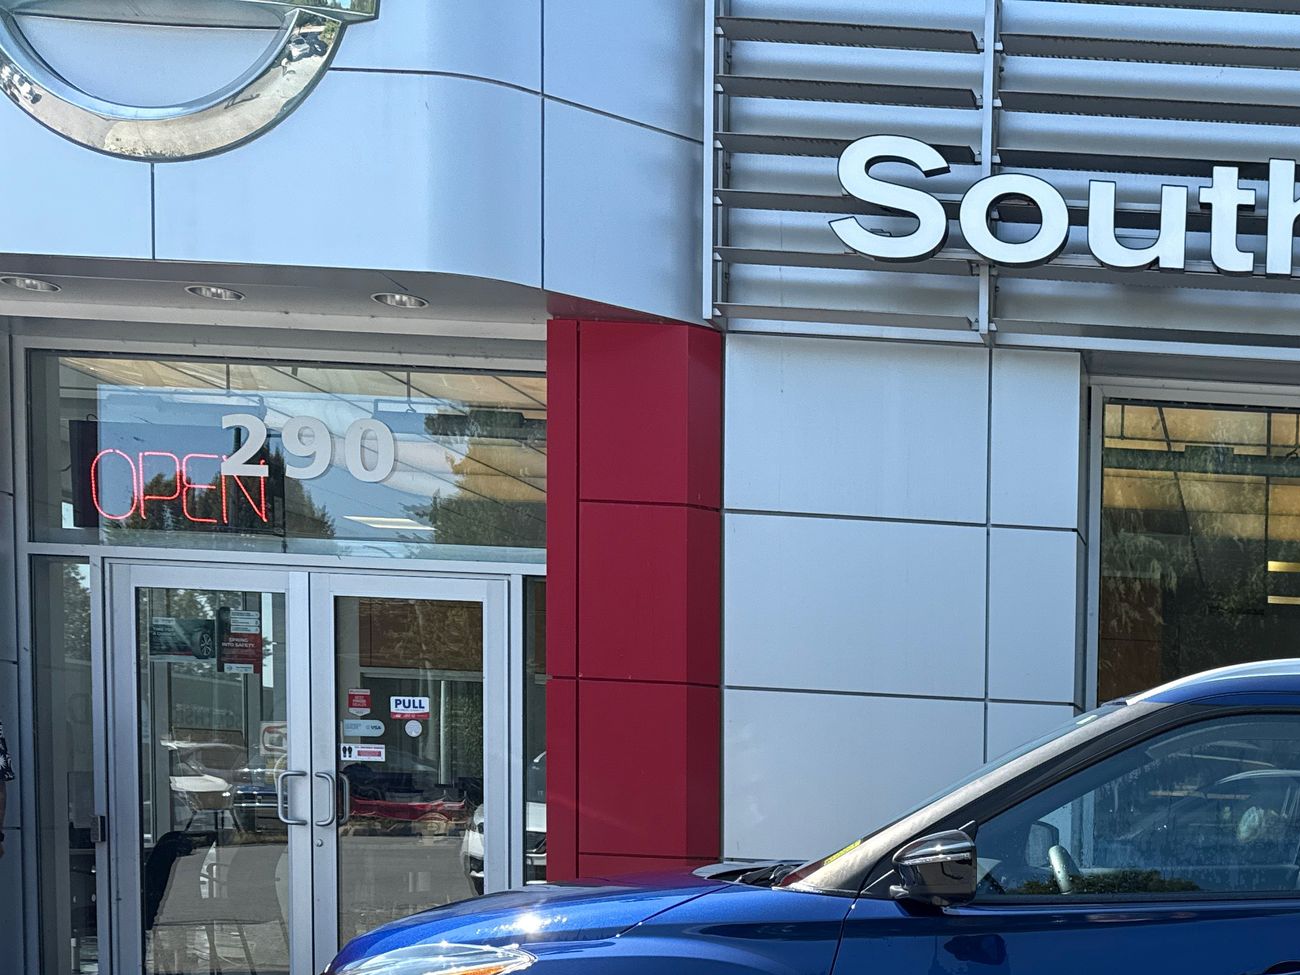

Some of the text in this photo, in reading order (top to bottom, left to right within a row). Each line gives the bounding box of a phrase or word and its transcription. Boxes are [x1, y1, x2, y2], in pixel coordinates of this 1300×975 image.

[221, 413, 395, 483] 290
[91, 448, 268, 524] OPEN
[394, 698, 425, 709] PULL
